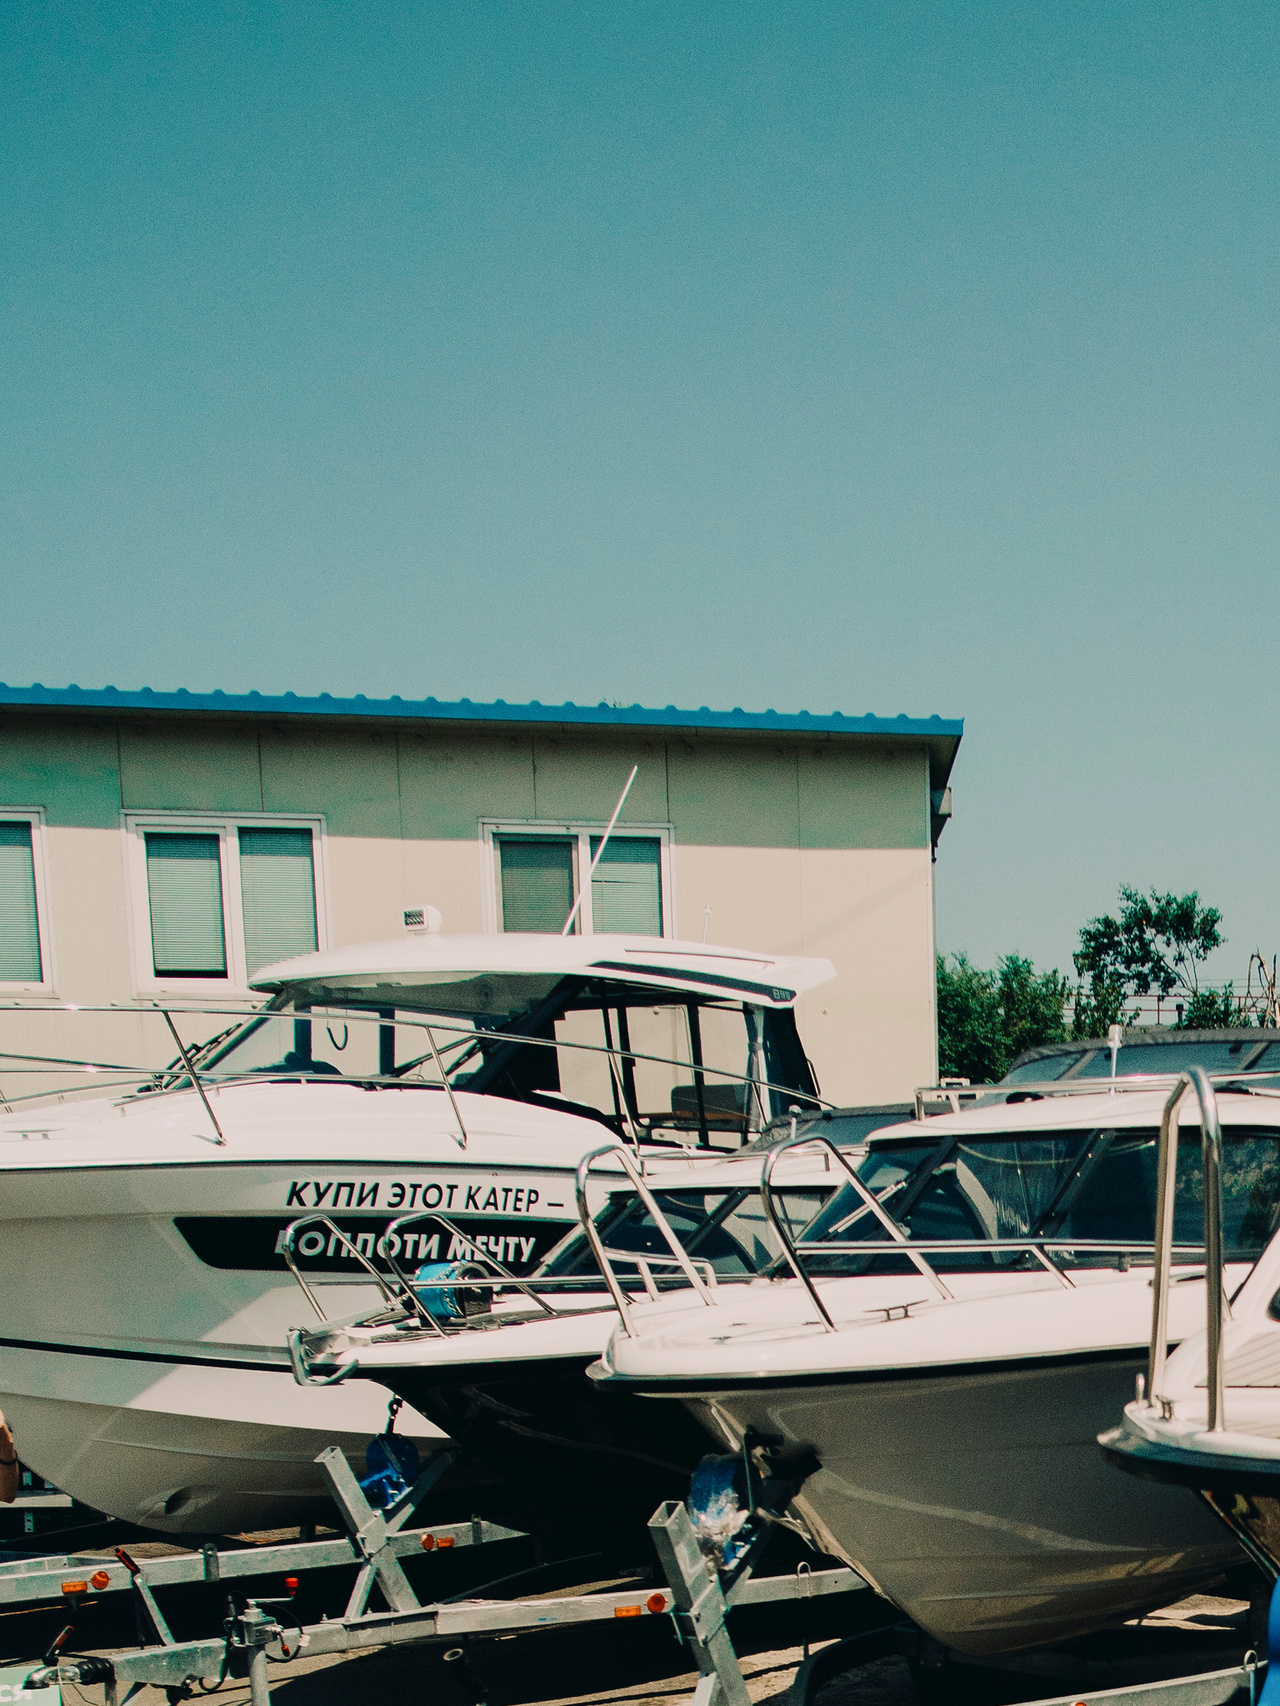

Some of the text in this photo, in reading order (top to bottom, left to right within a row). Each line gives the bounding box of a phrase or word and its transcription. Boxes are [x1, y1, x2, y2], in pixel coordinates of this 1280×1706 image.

[286, 1181, 379, 1207] КУПИ
[387, 1182, 458, 1209] ЭТОТ
[464, 1185, 540, 1212] КАТЕР
[446, 1234, 536, 1263] МЕЧТУ
